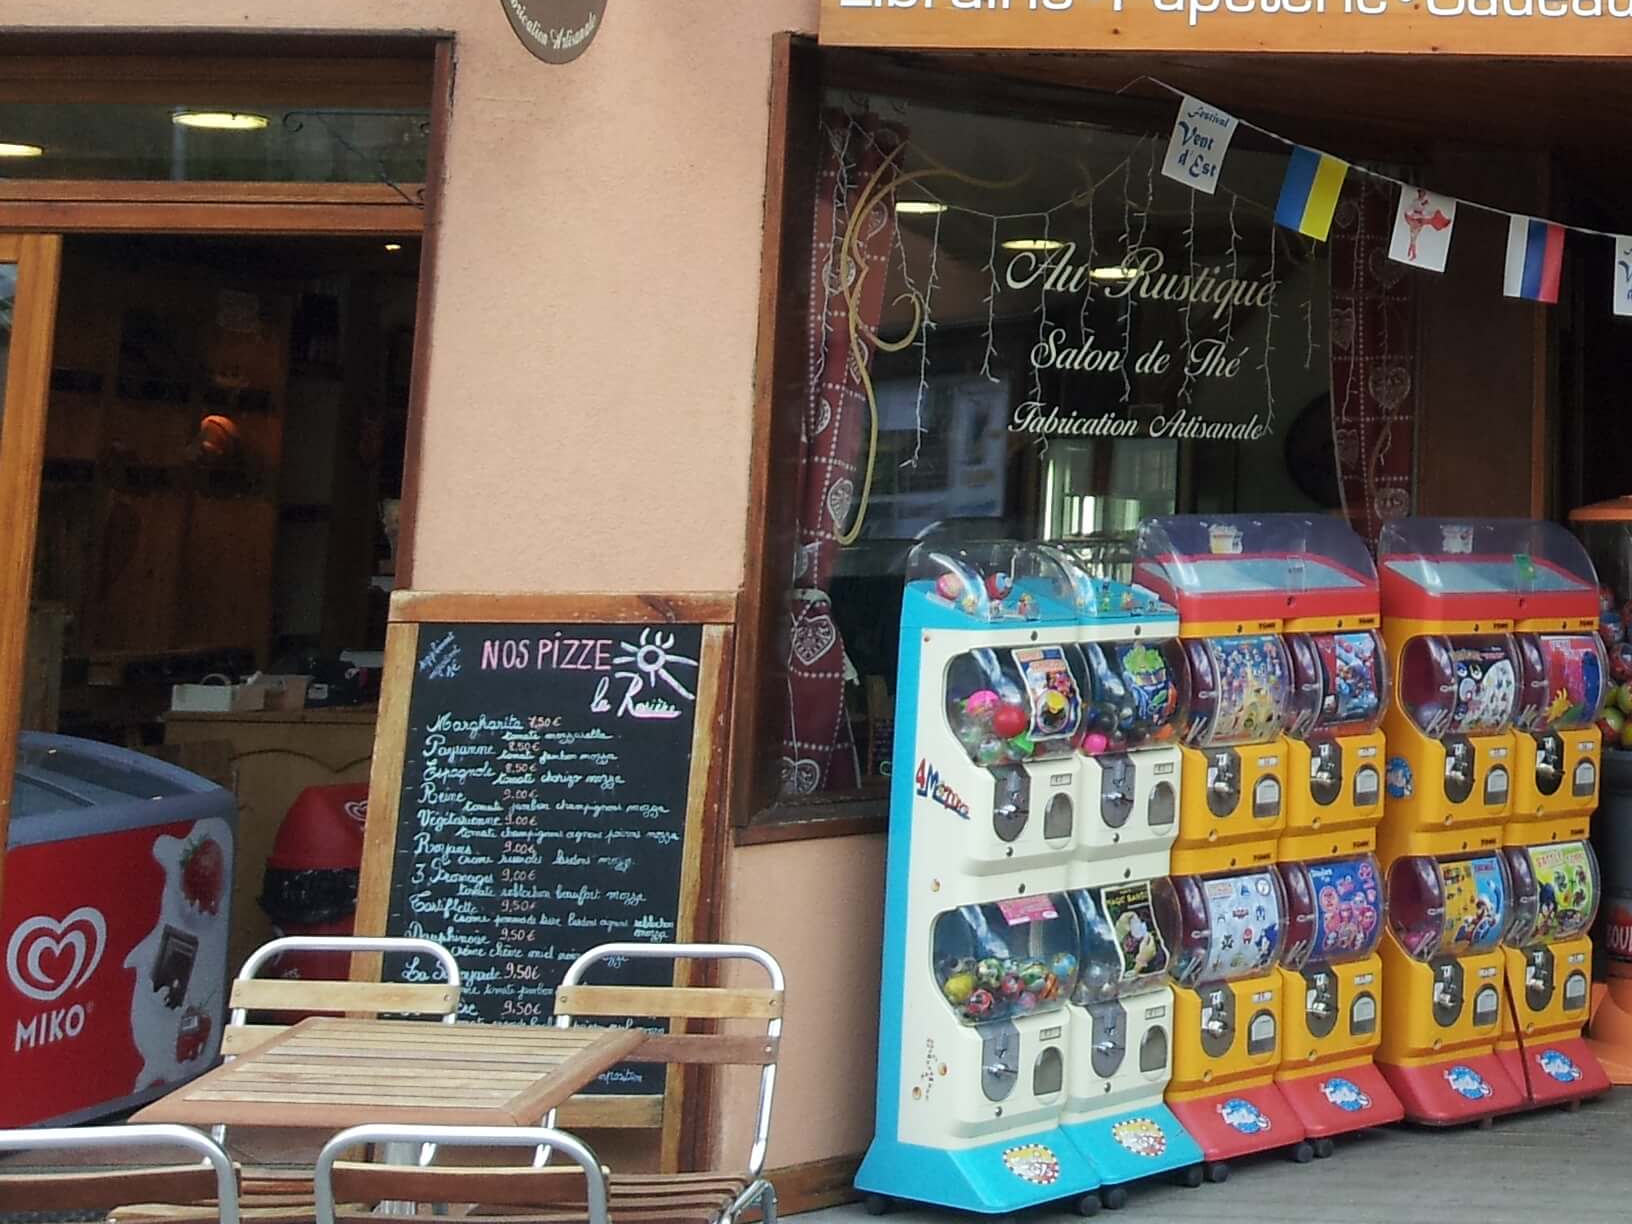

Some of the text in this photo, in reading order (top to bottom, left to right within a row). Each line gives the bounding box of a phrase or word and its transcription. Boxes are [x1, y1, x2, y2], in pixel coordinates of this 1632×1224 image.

[1178, 120, 1215, 151] Vent
[1006, 241, 1277, 320] Au Rustique
[1030, 328, 1249, 378] Salon de Thé
[1008, 401, 1139, 435] Fabrication
[480, 639, 529, 670] NOS
[537, 631, 614, 670] PIZZE
[411, 863, 426, 884] 3
[14, 1004, 86, 1053] MIKO
